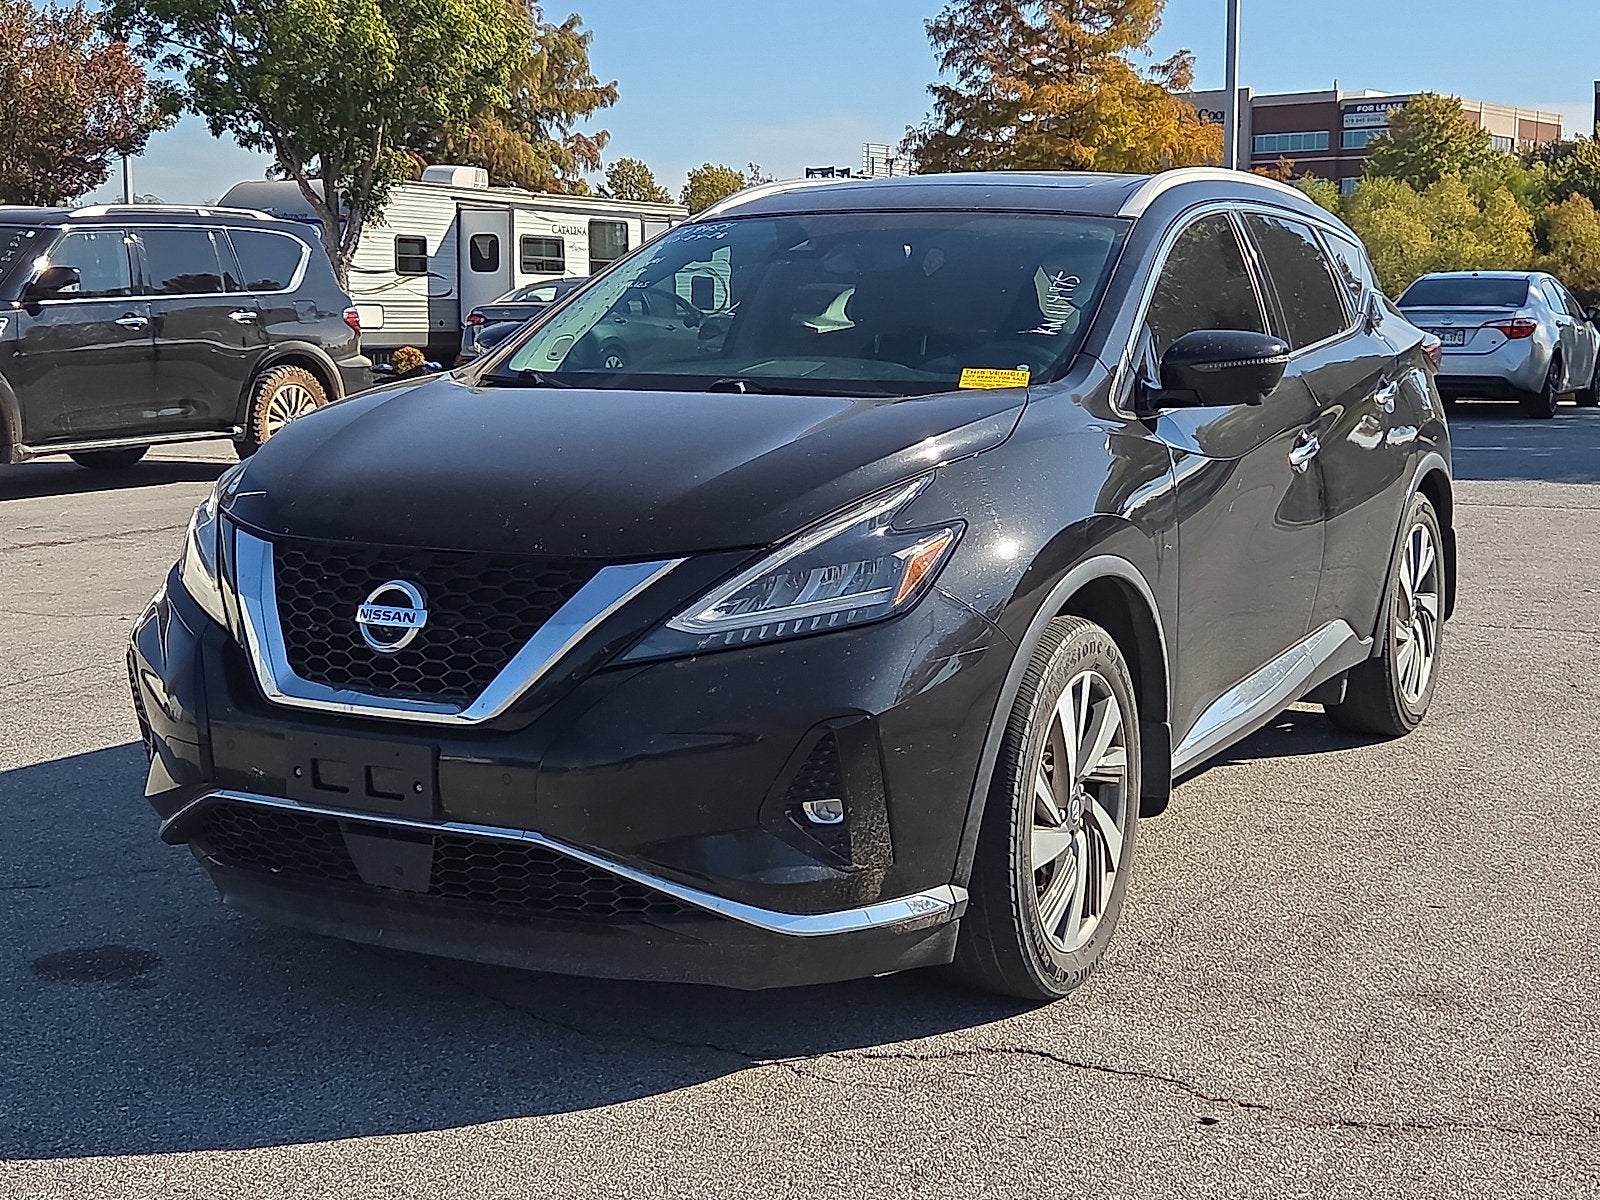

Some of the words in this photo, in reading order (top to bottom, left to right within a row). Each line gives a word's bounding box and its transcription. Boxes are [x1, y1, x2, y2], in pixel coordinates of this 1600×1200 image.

[1356, 104, 1375, 112] FOR
[551, 224, 588, 236] CATALINA
[360, 608, 416, 623] NISSAN
